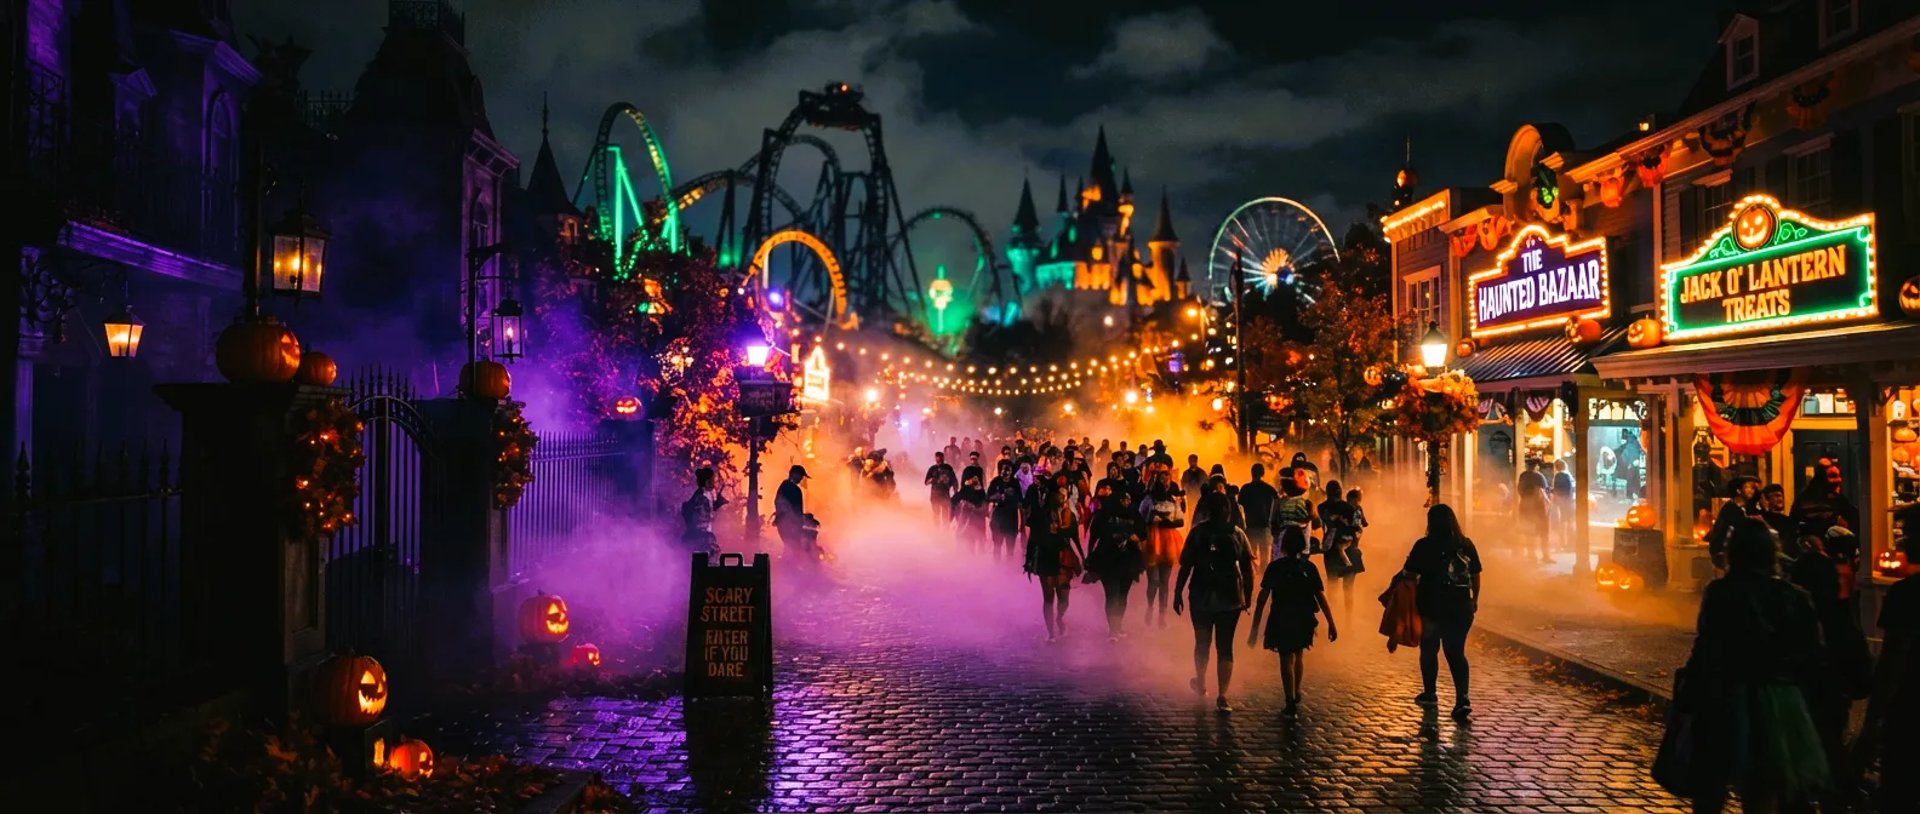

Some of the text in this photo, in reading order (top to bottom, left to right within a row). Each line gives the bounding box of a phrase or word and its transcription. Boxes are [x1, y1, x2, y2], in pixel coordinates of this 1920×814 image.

[1521, 249, 1543, 273] THE
[1680, 245, 1847, 304] JACK O' LANTERN
[1478, 259, 1600, 322] HAUNTED BAZAAR
[1722, 289, 1791, 322] TREATS
[705, 587, 753, 604] SCARY
[700, 605, 755, 622] STREET
[705, 629, 748, 645] ENTER
[704, 646, 748, 662] IF YOU
[708, 662, 744, 677] DARE
